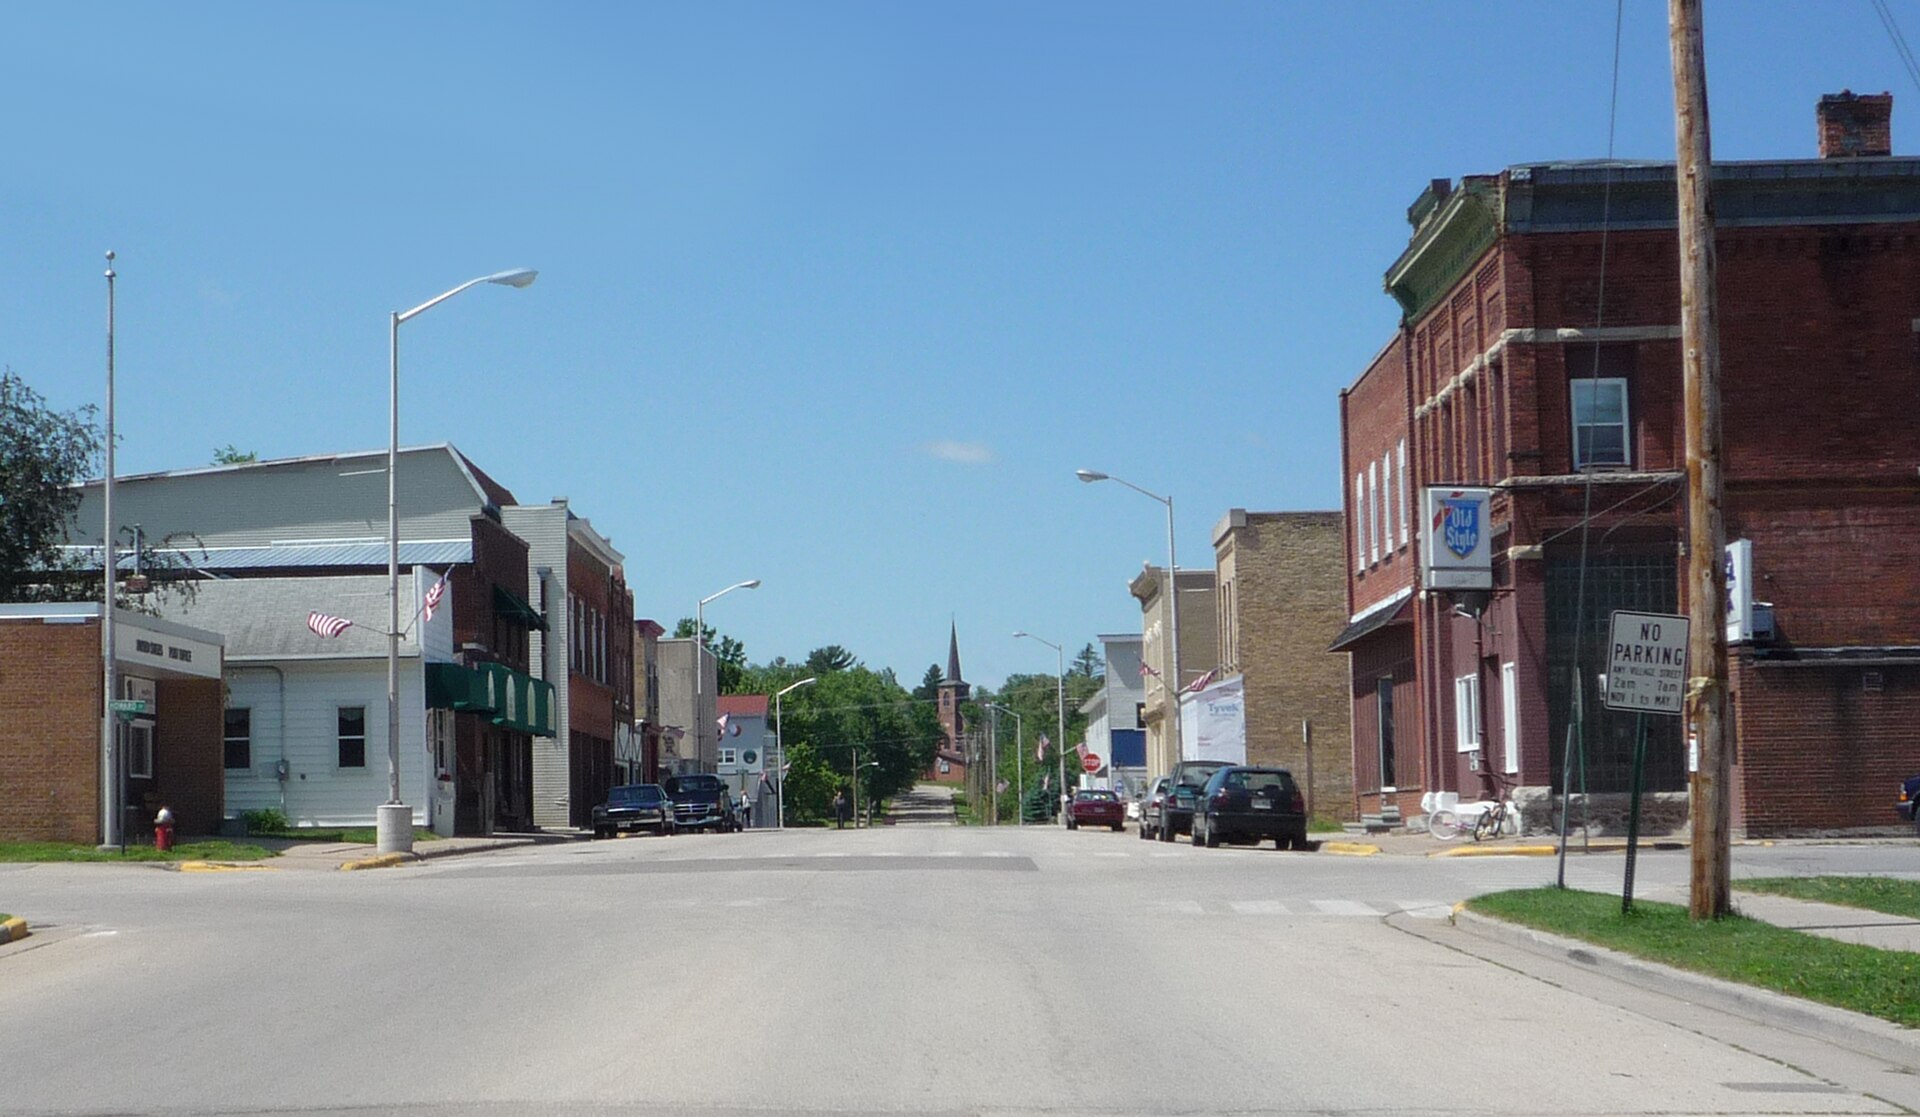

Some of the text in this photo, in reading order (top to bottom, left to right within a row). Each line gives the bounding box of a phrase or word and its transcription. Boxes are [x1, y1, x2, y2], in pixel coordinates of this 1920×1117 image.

[1452, 508, 1473, 528] Old
[1447, 526, 1477, 554] Style
[1641, 623, 1661, 642] NO
[1614, 643, 1683, 666] PARKING
[1613, 665, 1682, 679] ANY VILLAGE STREET
[1614, 677, 1635, 689] 2am
[1658, 680, 1678, 692] 7am
[1611, 691, 1625, 702] NOV
[1641, 695, 1649, 705] to
[1654, 696, 1670, 706] MAY
[1208, 702, 1238, 713] Tyvek
[1083, 758, 1100, 766] STOP
